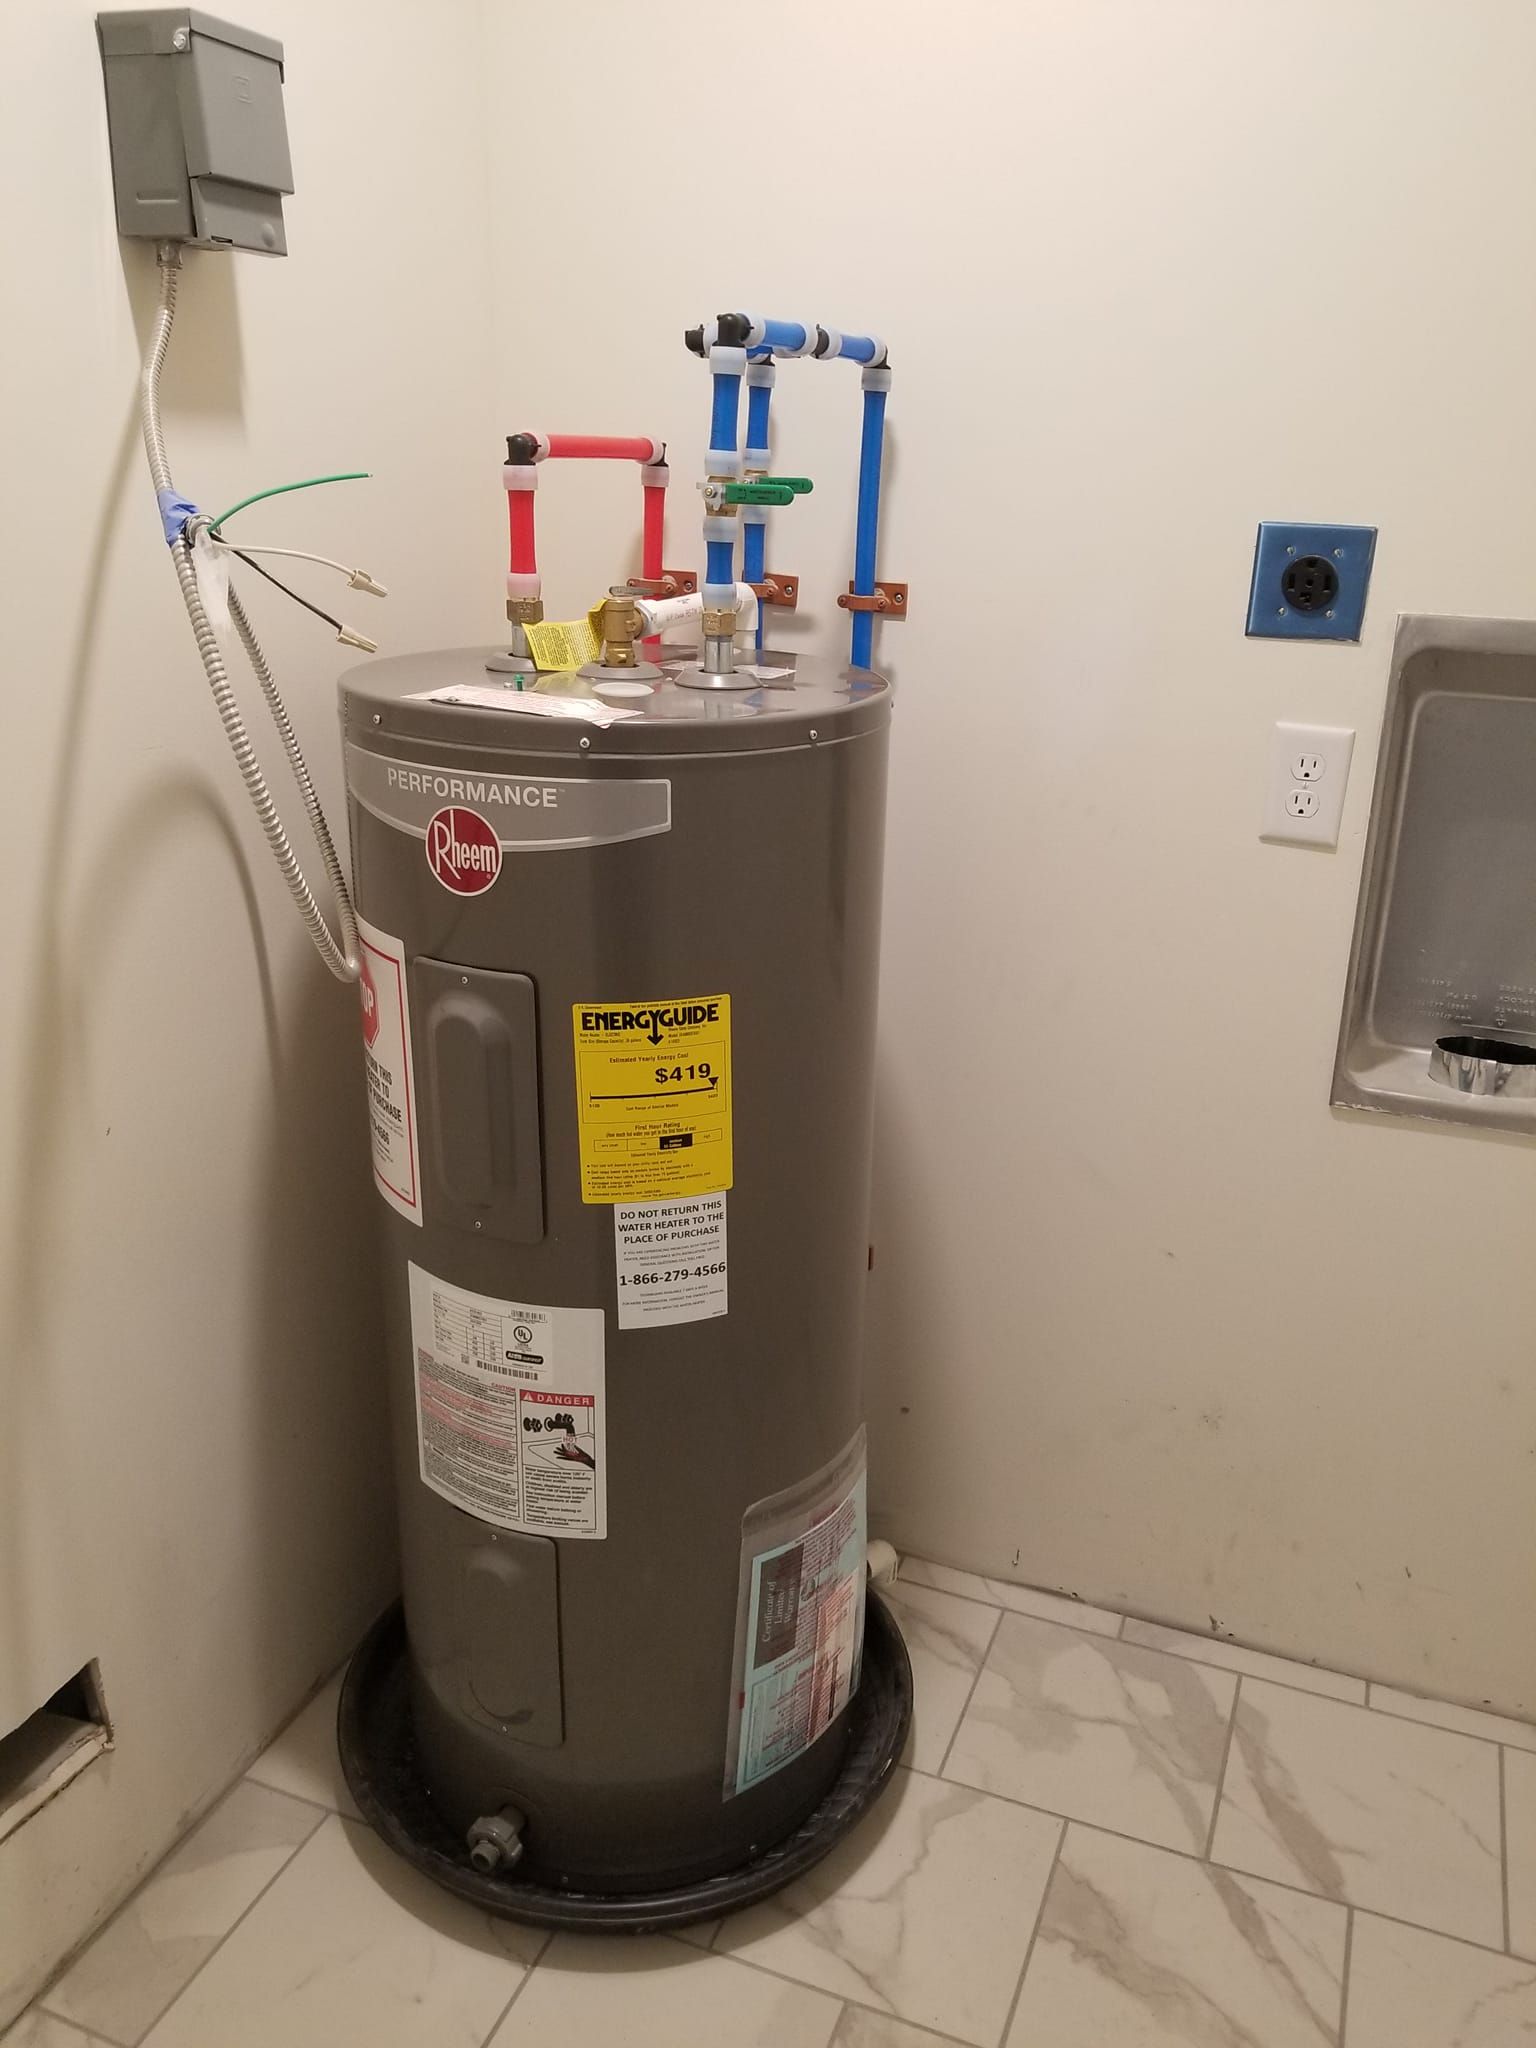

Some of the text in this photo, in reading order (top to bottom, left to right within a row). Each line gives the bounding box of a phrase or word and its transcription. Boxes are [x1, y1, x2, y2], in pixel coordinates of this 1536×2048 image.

[387, 767, 558, 808] PERFORMANCE
[434, 810, 497, 879] Rheem
[581, 1003, 719, 1032] ENERGYGUIDE
[638, 1055, 656, 1063] Yearly
[657, 1054, 676, 1062] Energy
[655, 1063, 711, 1085] $419
[620, 1200, 722, 1220] DO NOT RETURN THIS
[618, 1211, 725, 1232] WATER HEATER TO THE
[623, 1224, 720, 1244] PLACE OF PURCHASE
[619, 1261, 726, 1286] 1-866-279-4566
[536, 1393, 591, 1406] DANGER
